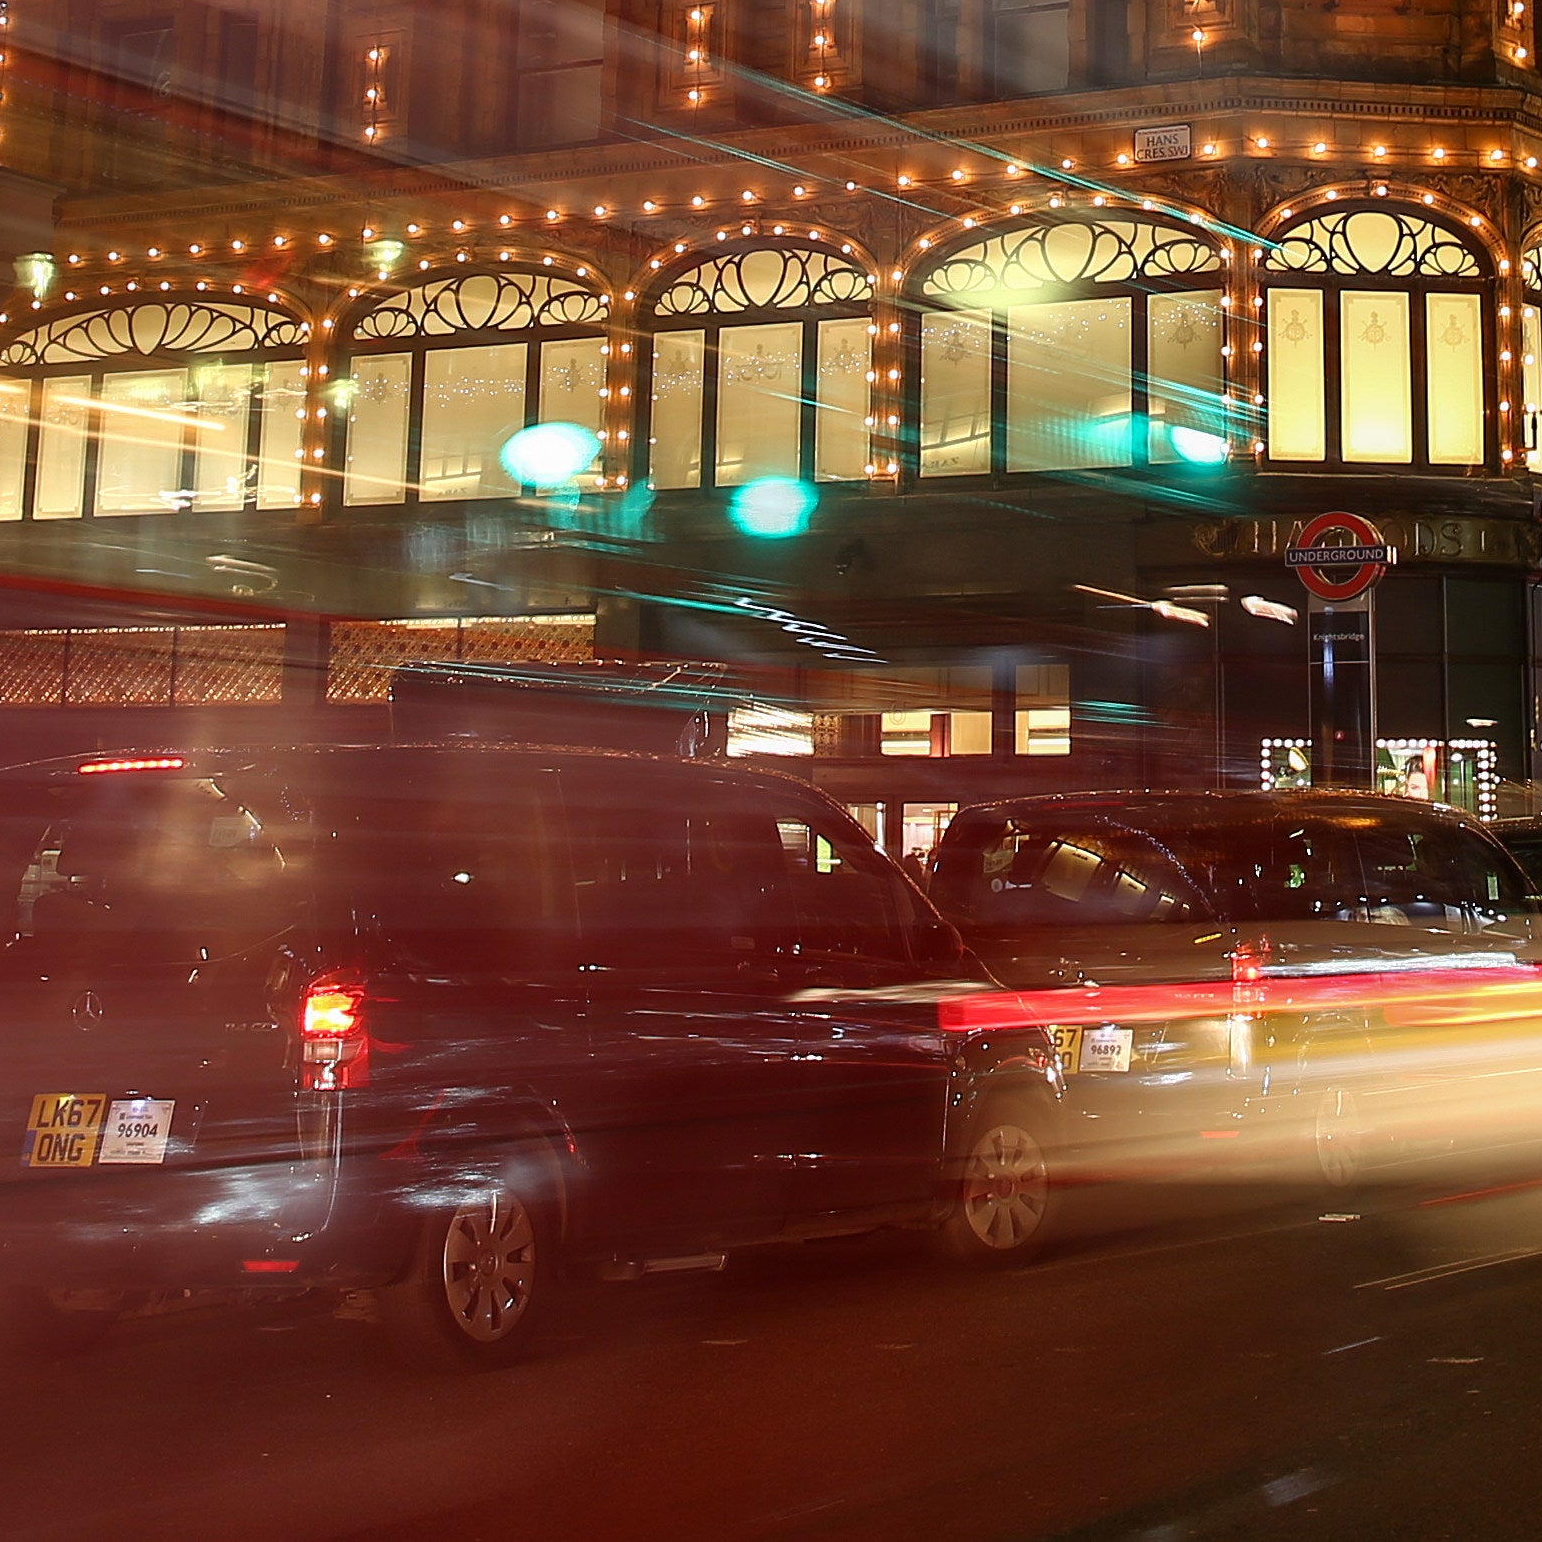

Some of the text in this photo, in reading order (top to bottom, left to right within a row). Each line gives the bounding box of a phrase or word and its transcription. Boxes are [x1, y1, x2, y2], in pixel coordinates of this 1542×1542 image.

[1147, 134, 1178, 147] HANS
[1168, 145, 1188, 158] SW1
[1289, 548, 1384, 563] UNDERGROUND
[1313, 633, 1365, 642] Knightsbridge
[36, 1099, 103, 1128] LK67
[118, 1122, 159, 1138] 96904
[37, 1133, 86, 1162] ONG
